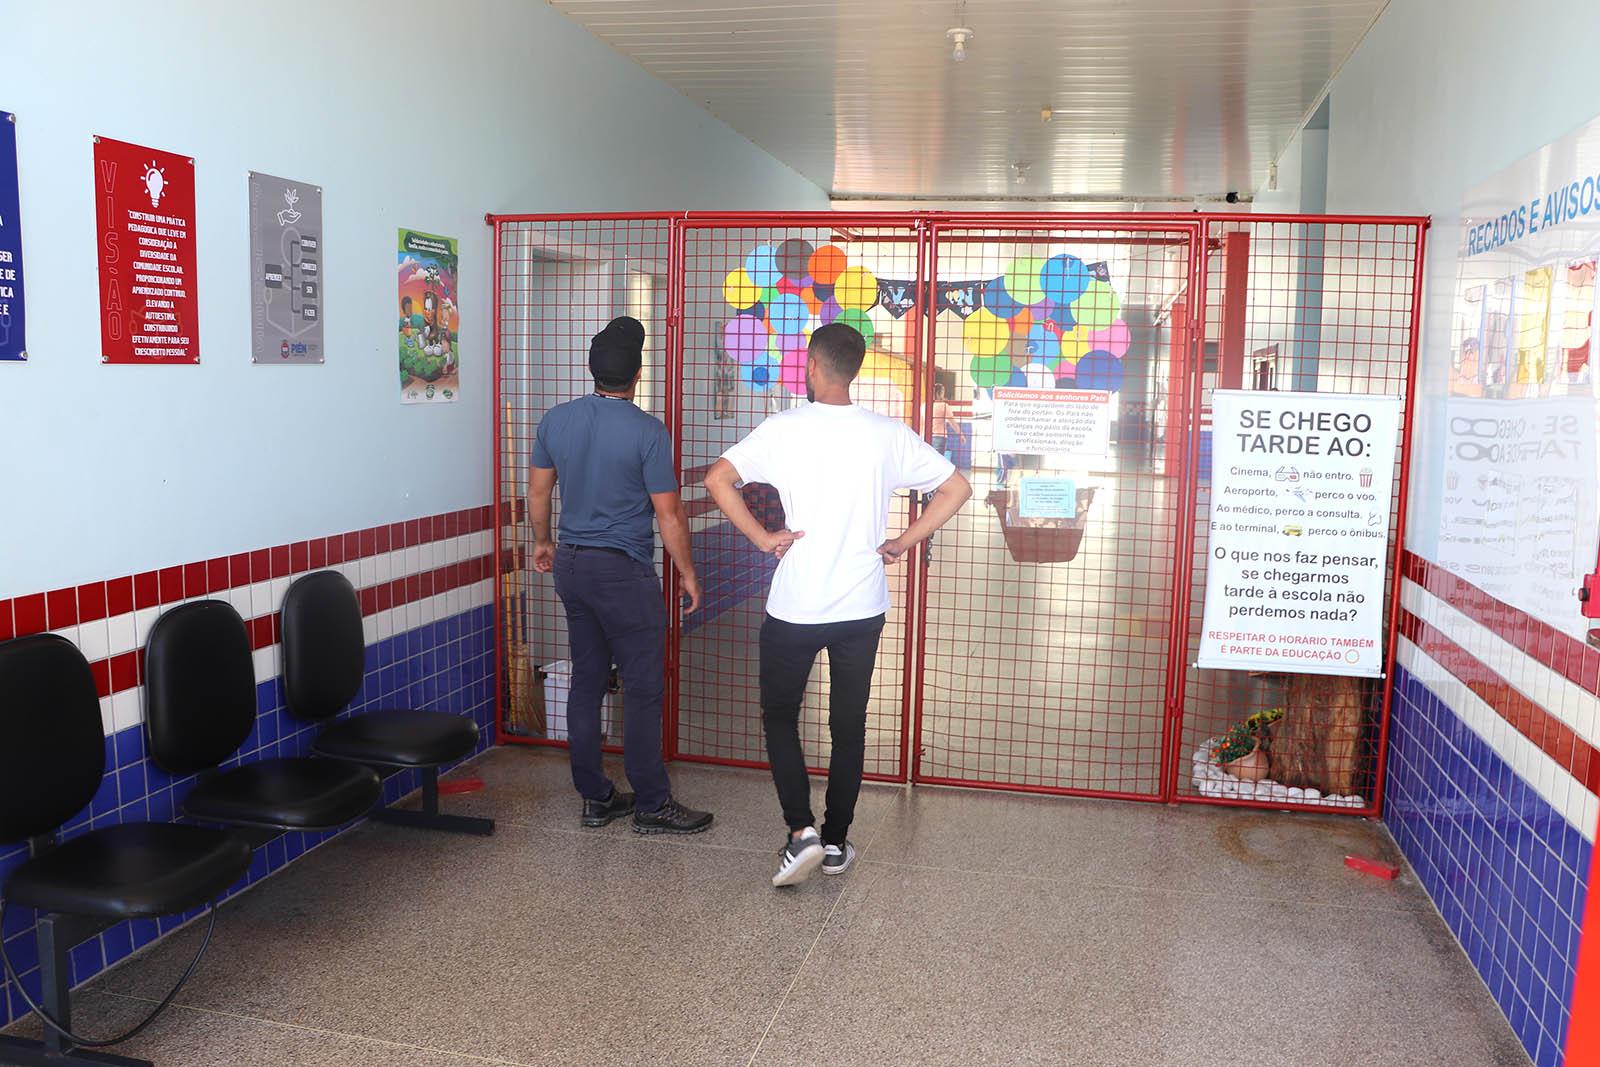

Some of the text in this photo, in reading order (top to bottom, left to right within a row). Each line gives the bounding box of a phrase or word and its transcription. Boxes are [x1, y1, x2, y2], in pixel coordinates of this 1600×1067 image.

[1468, 205, 1526, 256] RECADOS
[1529, 199, 1540, 234] E
[5, 269, 16, 281] DE
[997, 390, 1039, 400] Solicitamos
[1055, 393, 1089, 401] senhores
[1090, 394, 1106, 402] Pais
[1240, 409, 1372, 433] SE CHEGO
[1236, 433, 1371, 457] TARDE AO:
[1230, 466, 1354, 480] Cinema, não entro.
[1224, 486, 1278, 498] Aeroporto,
[1315, 490, 1344, 500] perco
[1216, 505, 1230, 514] Ao
[1232, 505, 1272, 516] médico,
[1276, 508, 1304, 517] perco
[1316, 510, 1363, 520] consulta.
[1211, 522, 1216, 530] E
[1235, 523, 1280, 534] terminal,
[1308, 528, 1338, 536] perco
[1350, 527, 1386, 538] ônibus.
[1214, 546, 1378, 568] O que nos faz pensar,
[1242, 568, 1349, 584] se chegarmos
[1224, 584, 1365, 604] tarde à escola não
[1229, 604, 1357, 622] perdemos nada?
[1208, 631, 1374, 648] RESPEITAR O HORÁRIO TAMBÉM
[1220, 644, 1342, 661] É PARTE DA EDUCAÇÃO
